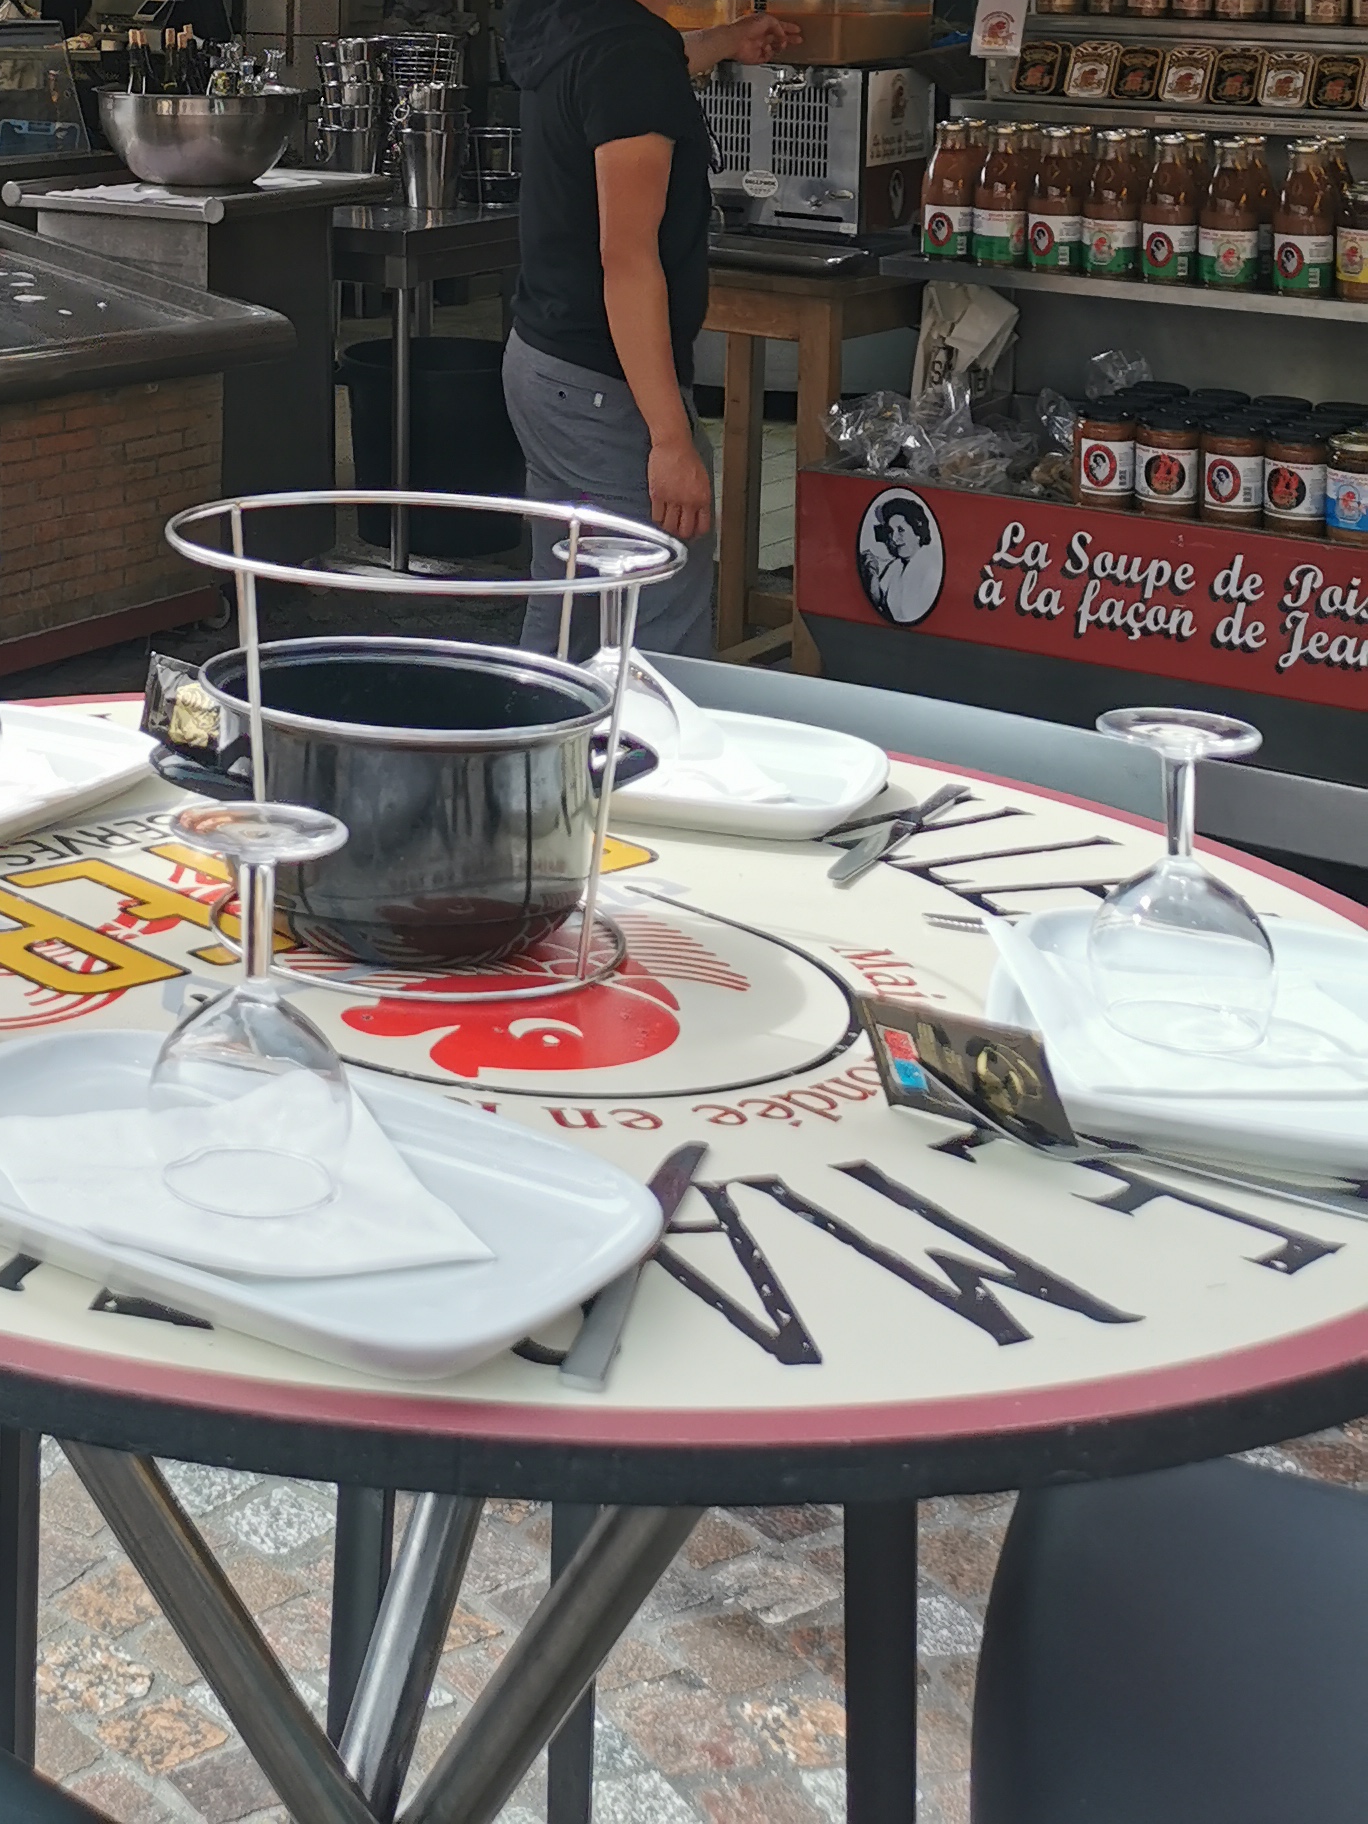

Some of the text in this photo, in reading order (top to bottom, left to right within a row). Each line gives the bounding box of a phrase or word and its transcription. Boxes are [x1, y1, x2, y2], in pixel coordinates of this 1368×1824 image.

[990, 520, 1052, 570] La
[1063, 529, 1196, 600] Soupe
[1212, 553, 1266, 602] de
[977, 564, 1006, 607] à
[1018, 569, 1065, 615] la
[1077, 578, 1197, 640] façon
[1214, 601, 1268, 649] de
[541, 1105, 664, 1131] en
[692, 1056, 882, 1129] ondée
